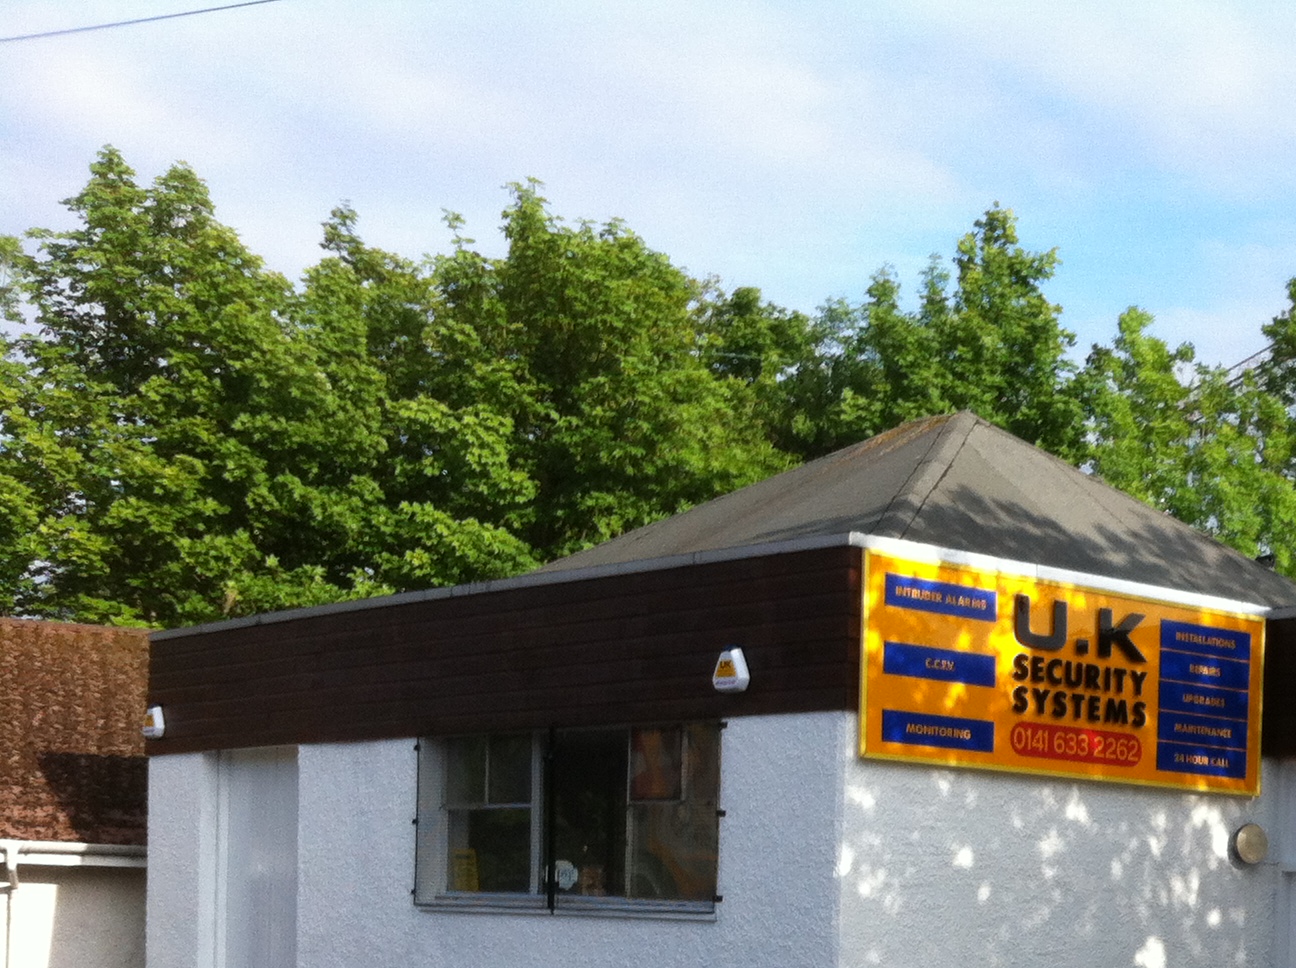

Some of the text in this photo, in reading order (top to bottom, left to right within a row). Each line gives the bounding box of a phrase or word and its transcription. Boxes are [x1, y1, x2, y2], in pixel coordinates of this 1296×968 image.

[1012, 653, 1148, 697] SECURITY
[1012, 685, 1147, 728] SYSTEMS
[905, 722, 972, 741] MONITORING
[1013, 726, 1139, 762] 0141 633 2262
[1174, 722, 1232, 739] MAINTENANCE
[1186, 754, 1209, 767] HOUR
